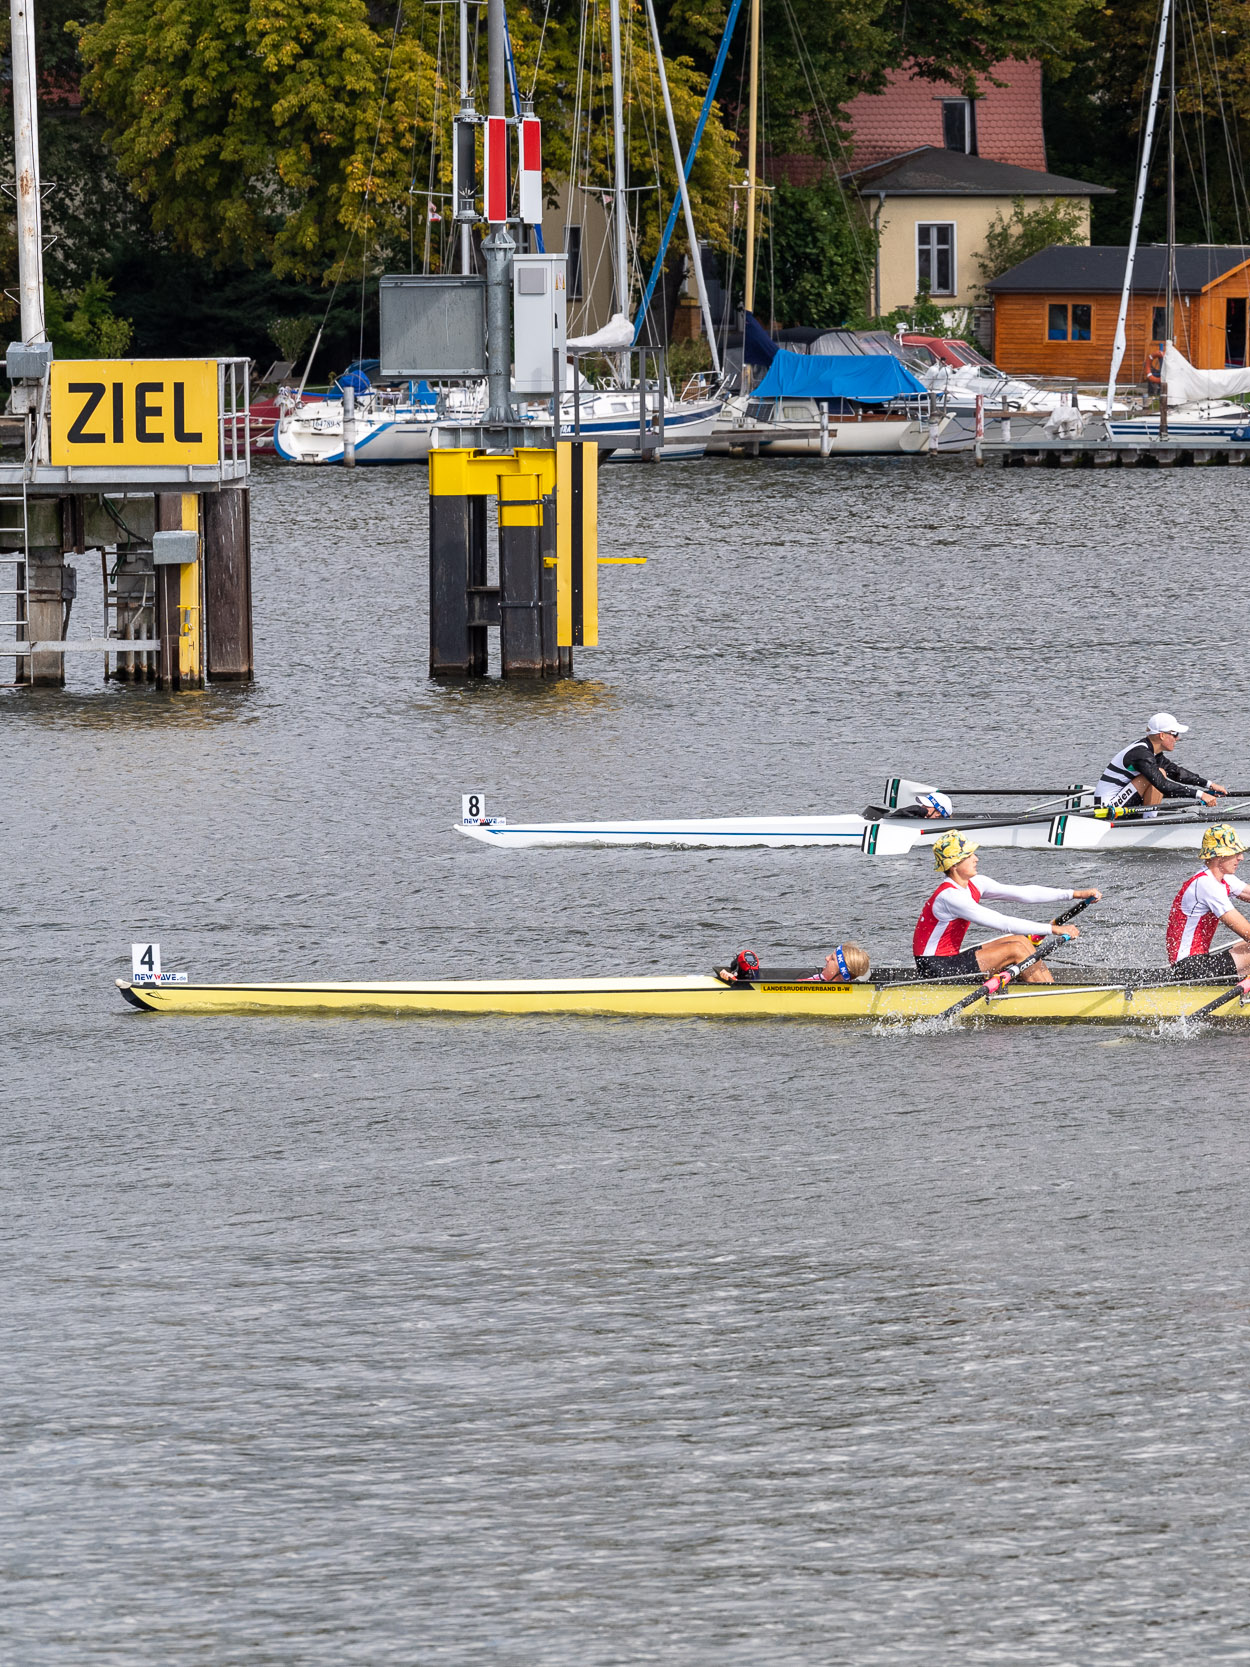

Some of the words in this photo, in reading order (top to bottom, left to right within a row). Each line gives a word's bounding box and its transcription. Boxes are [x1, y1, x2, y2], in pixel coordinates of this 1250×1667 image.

[67, 382, 202, 443] ZIEL
[469, 795, 480, 817] 8
[140, 944, 154, 971] 4
